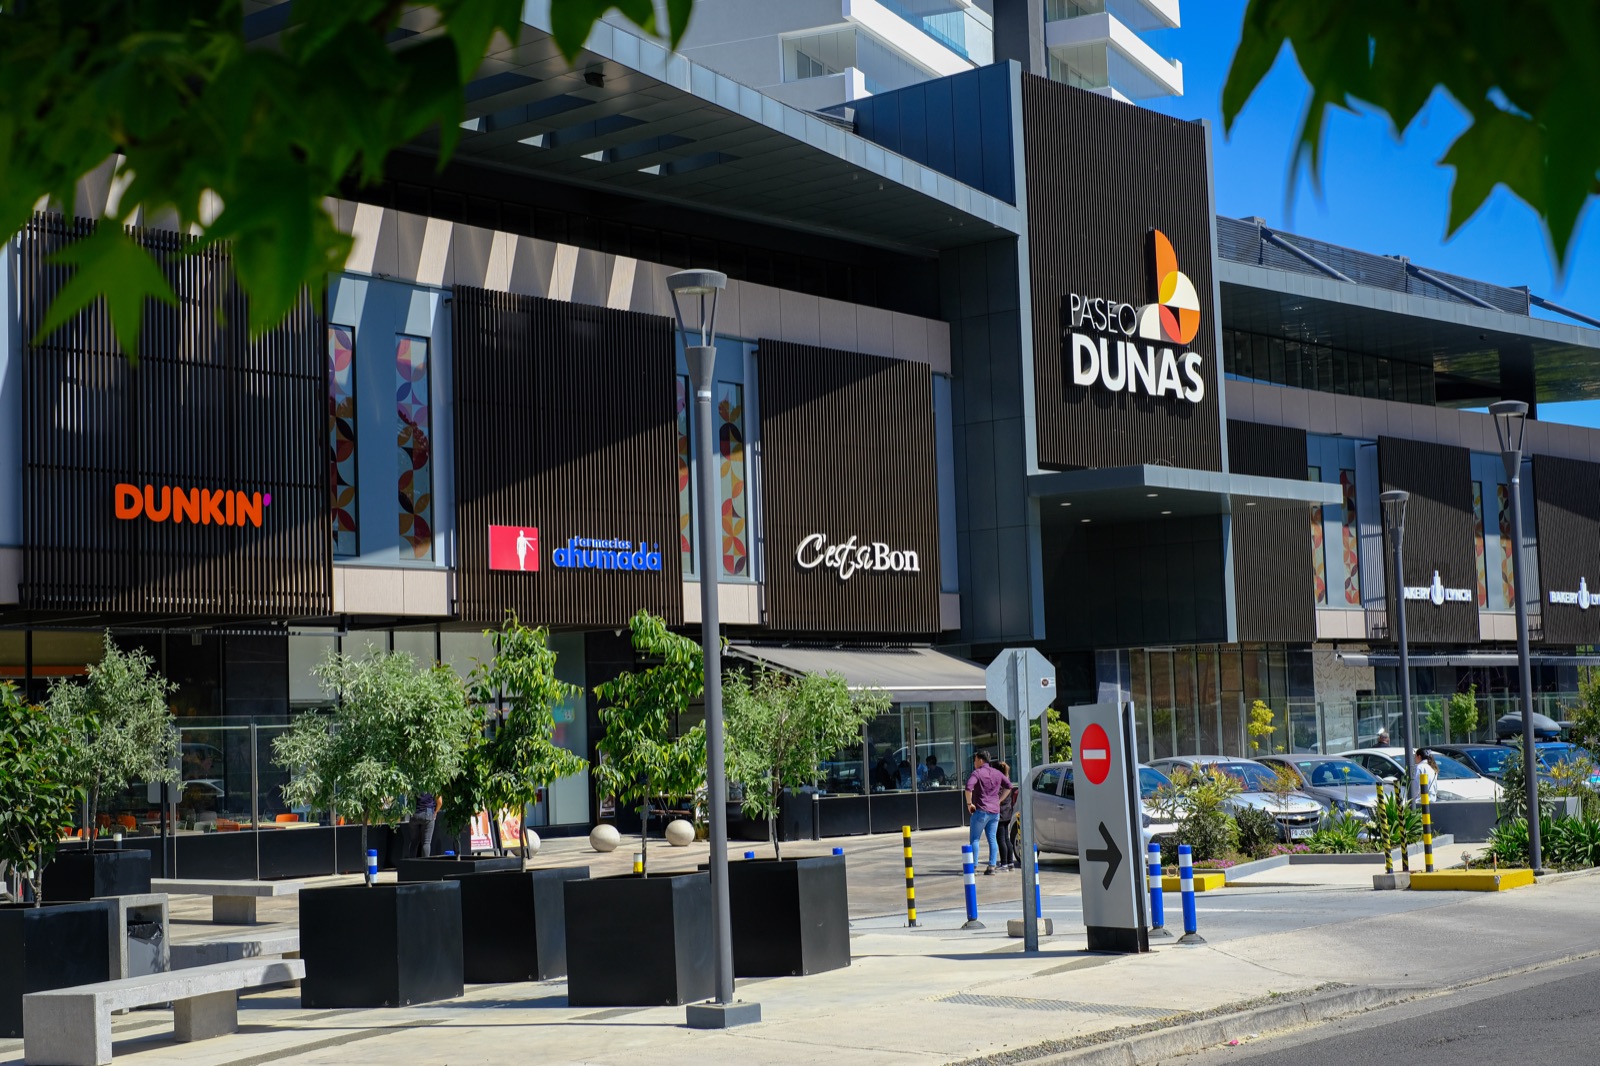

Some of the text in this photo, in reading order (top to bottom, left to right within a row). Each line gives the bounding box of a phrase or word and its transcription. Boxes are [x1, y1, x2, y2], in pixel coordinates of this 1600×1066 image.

[1068, 292, 1138, 336] PASEO
[1071, 332, 1205, 403] DUNAS
[114, 483, 272, 528] DUNKIN'
[552, 537, 662, 571] ahumada
[574, 535, 633, 550] farmacias
[871, 541, 920, 572] Bon
[1403, 586, 1472, 602] AKERY LYNCH
[1549, 590, 1579, 605] BAKERY
